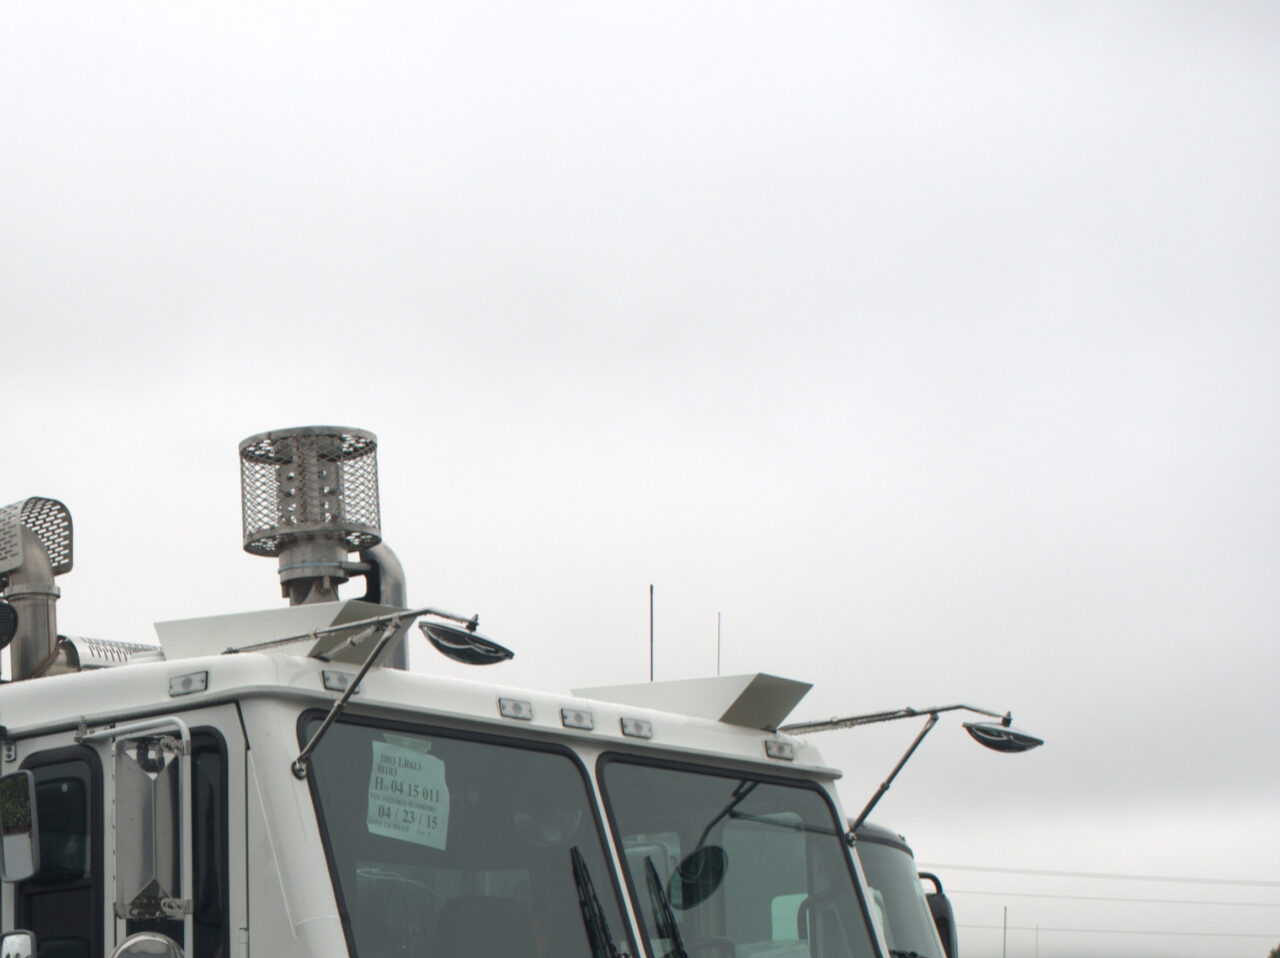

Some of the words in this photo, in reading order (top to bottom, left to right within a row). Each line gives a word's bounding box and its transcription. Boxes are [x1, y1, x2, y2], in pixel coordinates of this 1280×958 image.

[391, 780, 403, 794] 04
[408, 784, 419, 799] 15
[422, 786, 439, 803] 011
[378, 804, 391, 819] 04
[402, 809, 415, 824] 23
[426, 814, 438, 830] 15
